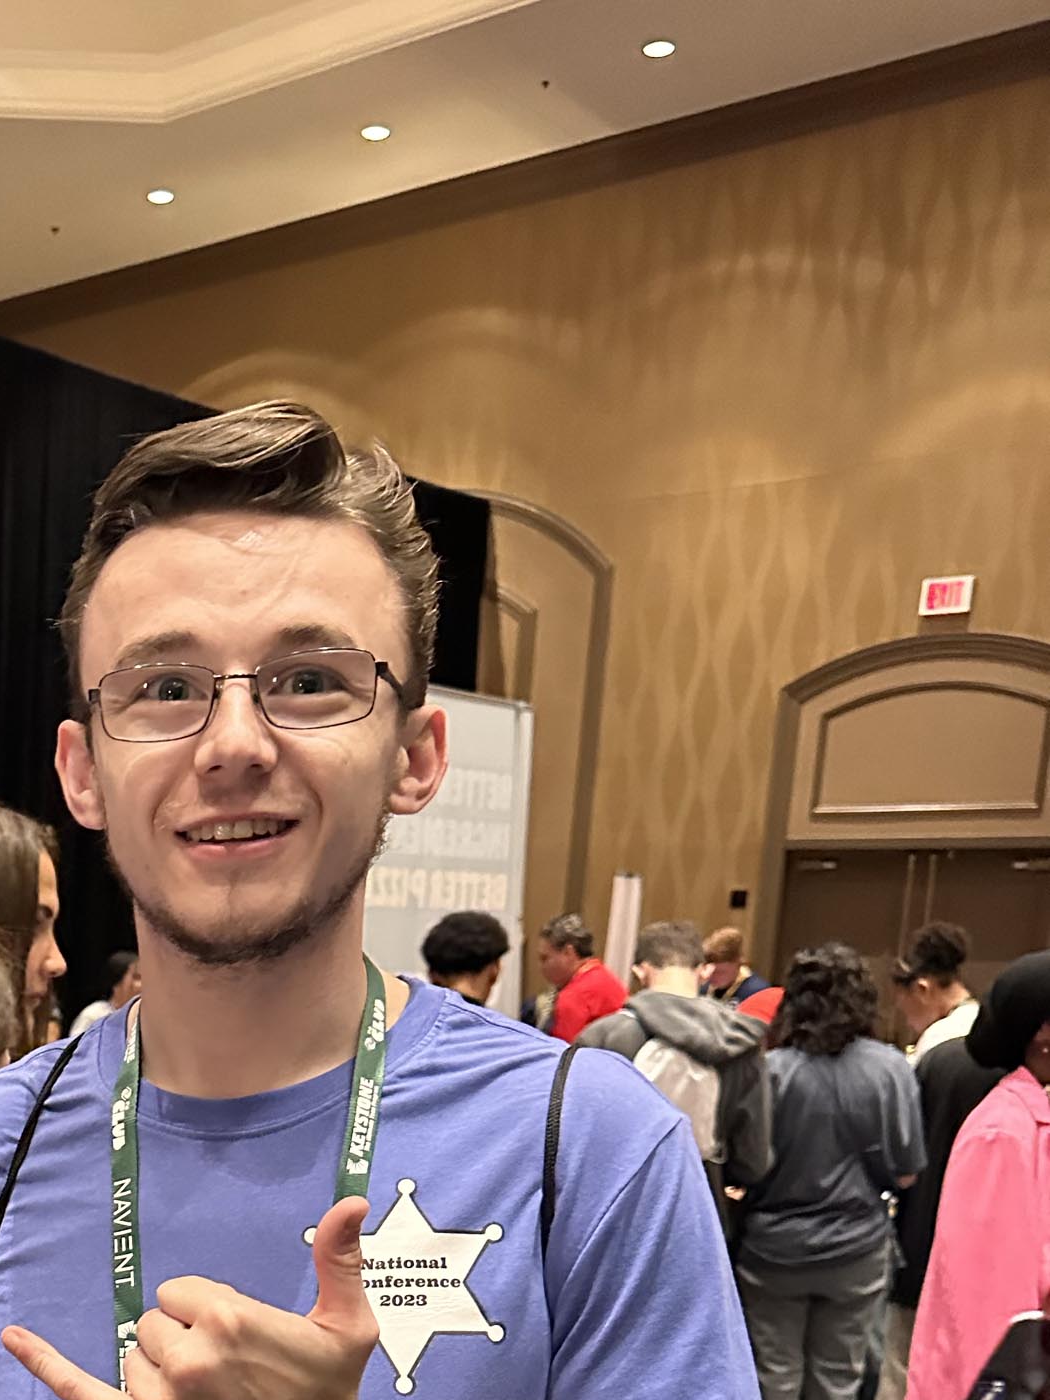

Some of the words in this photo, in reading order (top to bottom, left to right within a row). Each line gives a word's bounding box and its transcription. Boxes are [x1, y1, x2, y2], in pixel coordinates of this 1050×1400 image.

[350, 1077, 374, 1155] KEYSTONE
[361, 1257, 447, 1271] National
[362, 1275, 461, 1289] onference
[379, 1294, 428, 1307] 2023
